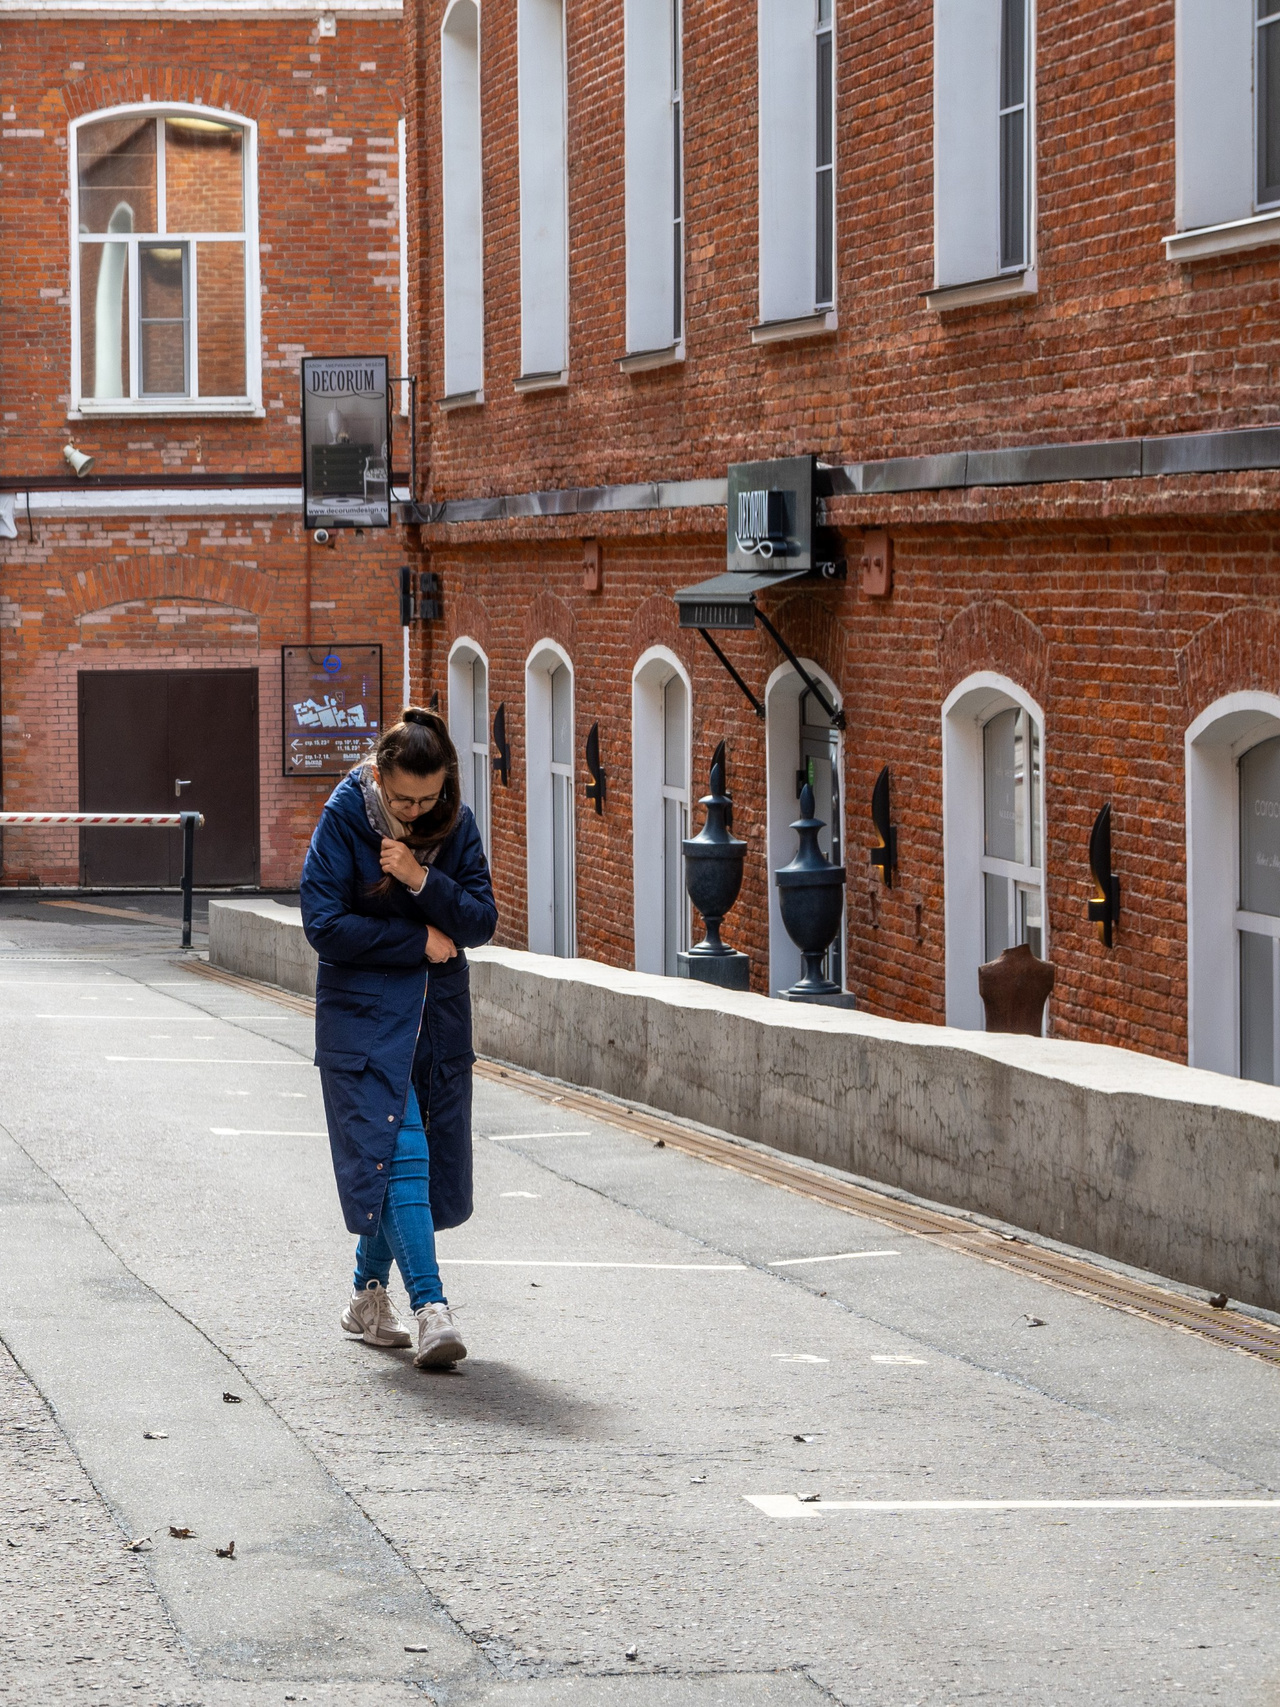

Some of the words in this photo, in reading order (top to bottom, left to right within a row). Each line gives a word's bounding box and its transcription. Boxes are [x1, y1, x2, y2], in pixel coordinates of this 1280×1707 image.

[312, 369, 376, 393] DECORUM
[308, 506, 387, 515] www.decorumdesign.ru
[1255, 800, 1280, 818] carac
